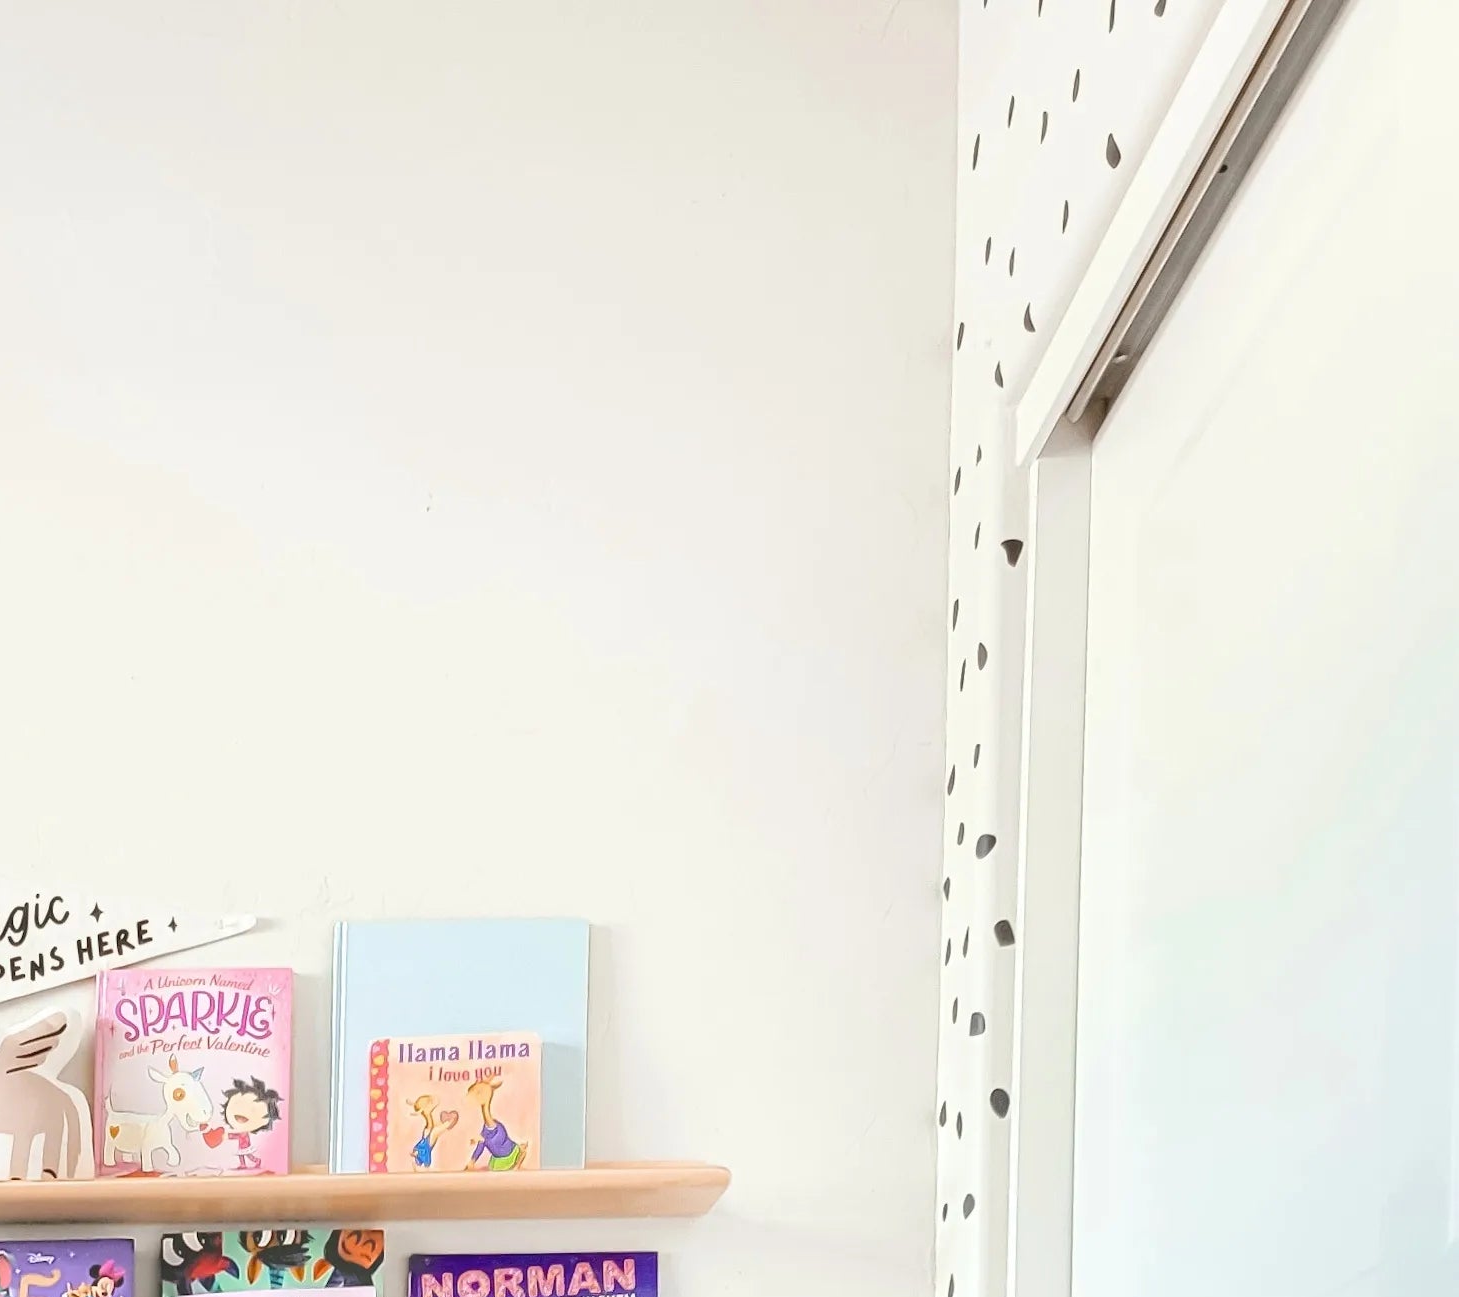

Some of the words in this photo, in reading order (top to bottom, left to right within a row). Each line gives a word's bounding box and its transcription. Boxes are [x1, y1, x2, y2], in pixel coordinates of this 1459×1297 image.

[77, 919, 153, 964] HERE
[144, 979, 153, 991] A
[158, 975, 206, 988] Unicorn
[209, 974, 254, 991] Named
[115, 991, 273, 1042] SPARKLE
[119, 1046, 135, 1060] and
[150, 1034, 202, 1055] Perfect
[206, 1035, 271, 1058] Valentine
[399, 1043, 460, 1063] llama
[468, 1040, 530, 1059] llama
[439, 1067, 470, 1082] love
[475, 1066, 502, 1081] you
